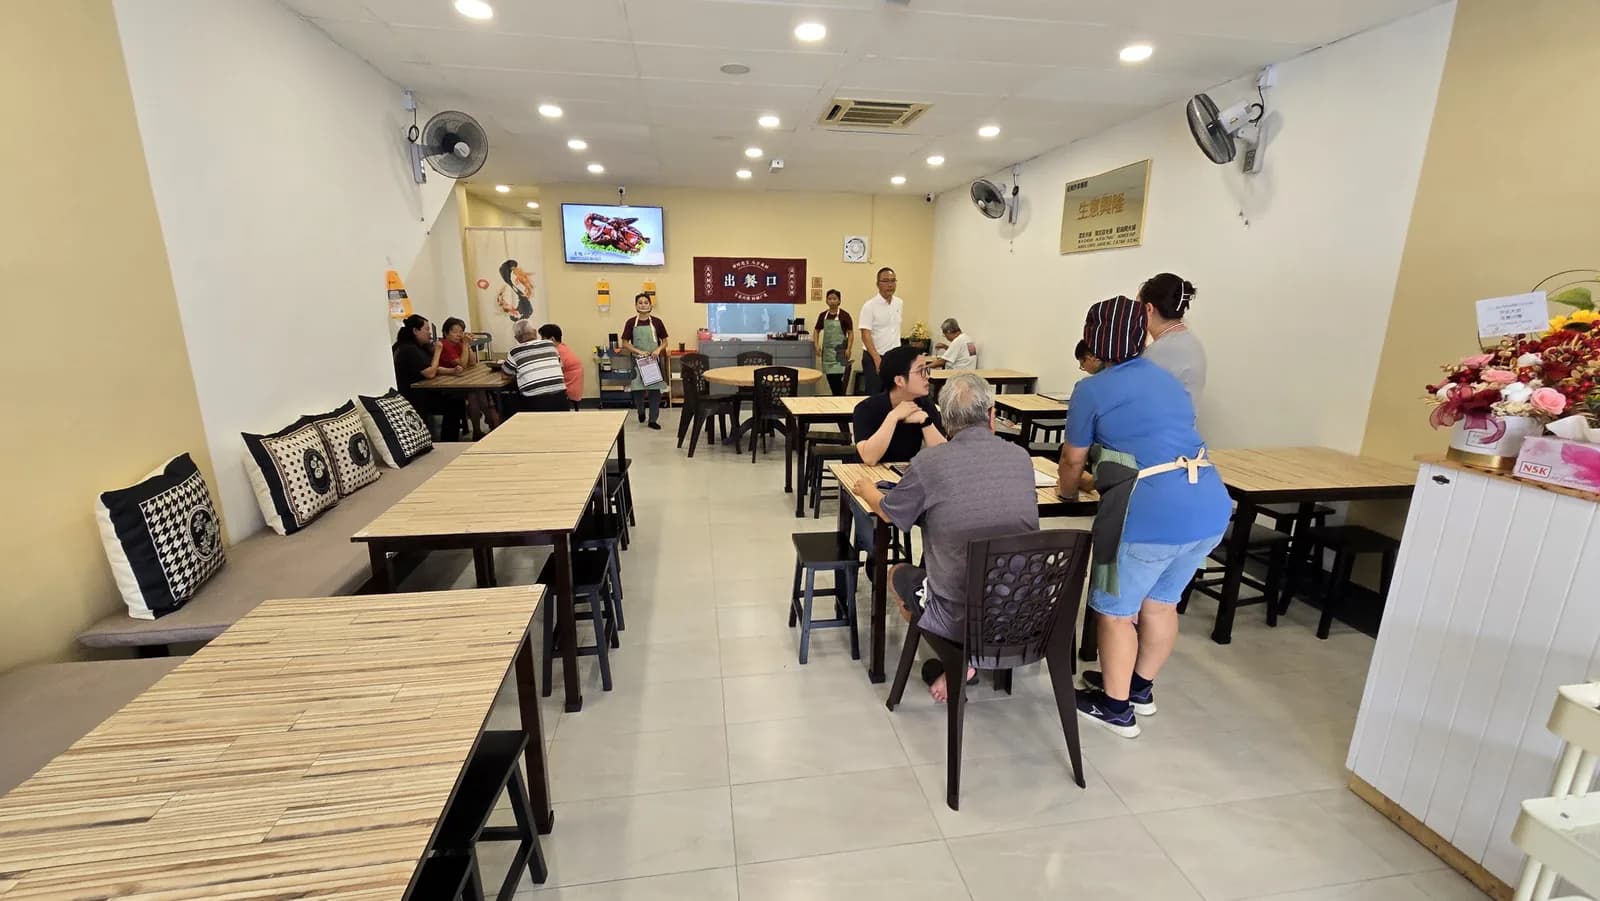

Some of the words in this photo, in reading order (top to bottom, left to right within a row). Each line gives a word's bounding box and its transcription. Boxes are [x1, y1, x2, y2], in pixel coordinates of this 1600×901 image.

[724, 274, 777, 288] 出餐口
[1523, 464, 1548, 476] NSK
